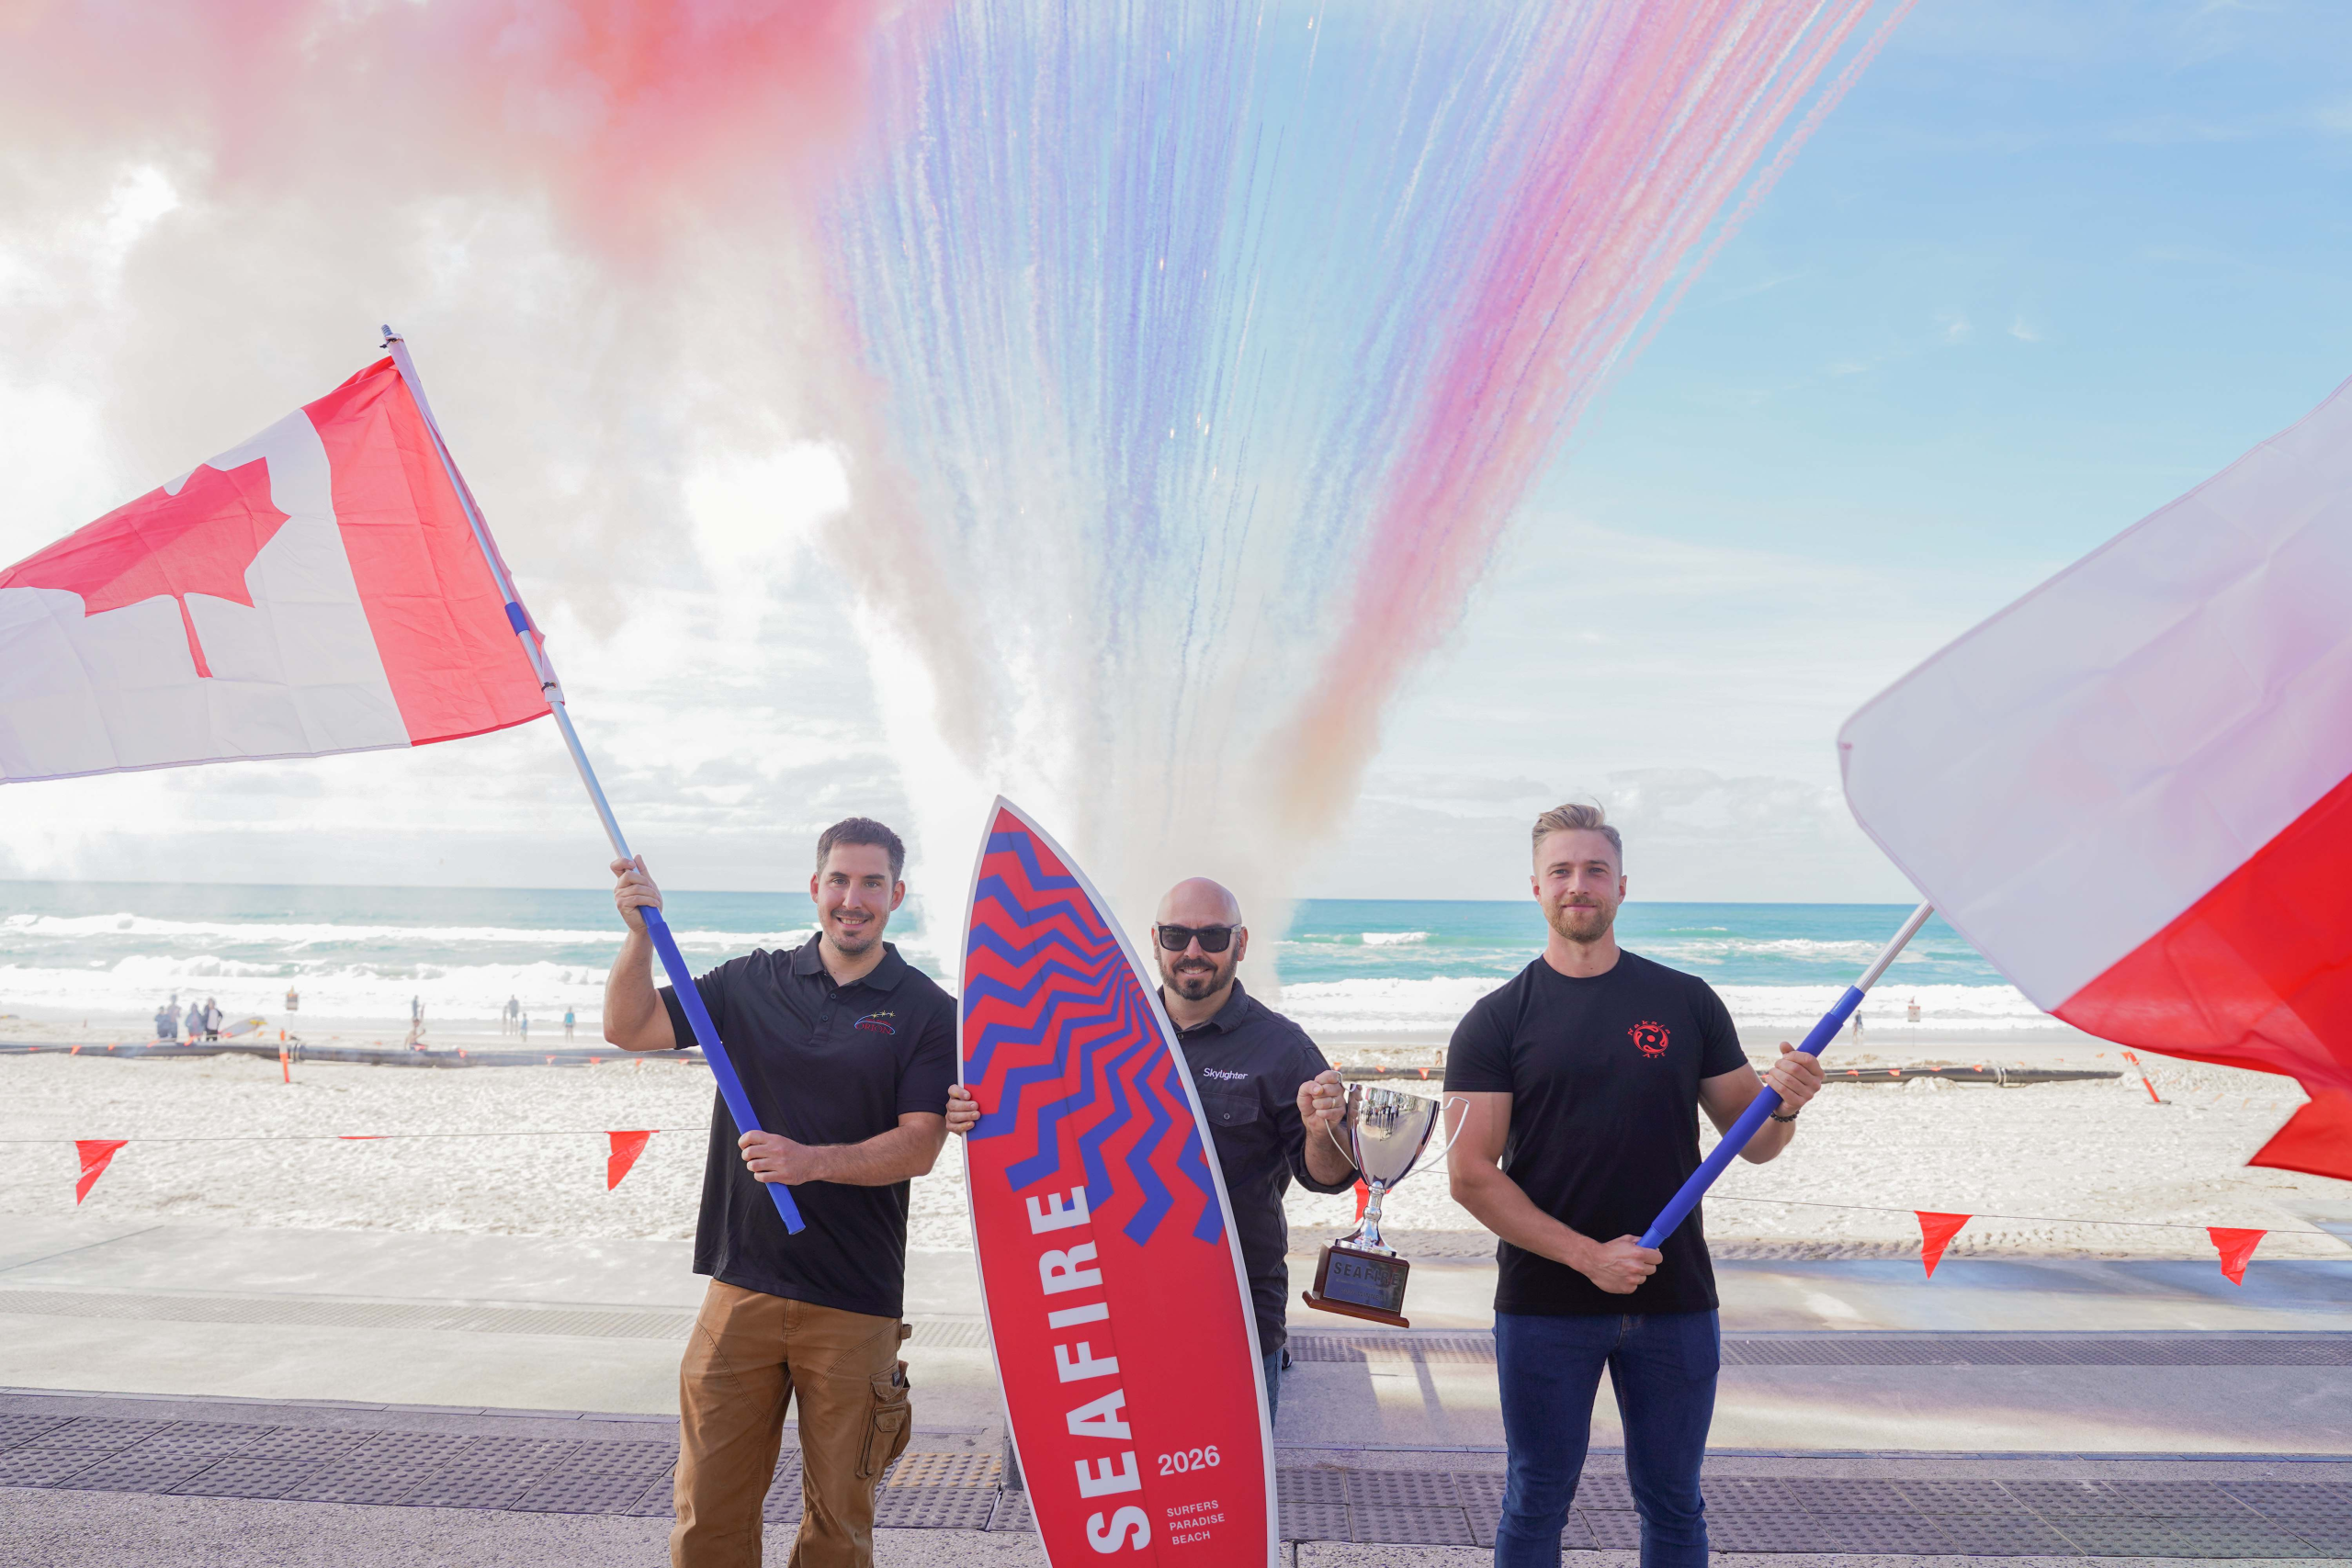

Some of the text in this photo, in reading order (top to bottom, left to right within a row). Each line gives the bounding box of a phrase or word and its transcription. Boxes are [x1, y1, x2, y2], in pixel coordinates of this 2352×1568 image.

[855, 1021, 891, 1033] ORION
[1203, 1067, 1249, 1080] Skylighter
[1333, 1261, 1400, 1286] SEAFIRE
[1025, 1185, 1151, 1554] SEAFIRE
[1158, 1445, 1220, 1476] 2026
[1166, 1499, 1219, 1517] SURFERS
[1169, 1513, 1226, 1531] PARADISE
[1171, 1530, 1211, 1545] BEACH
